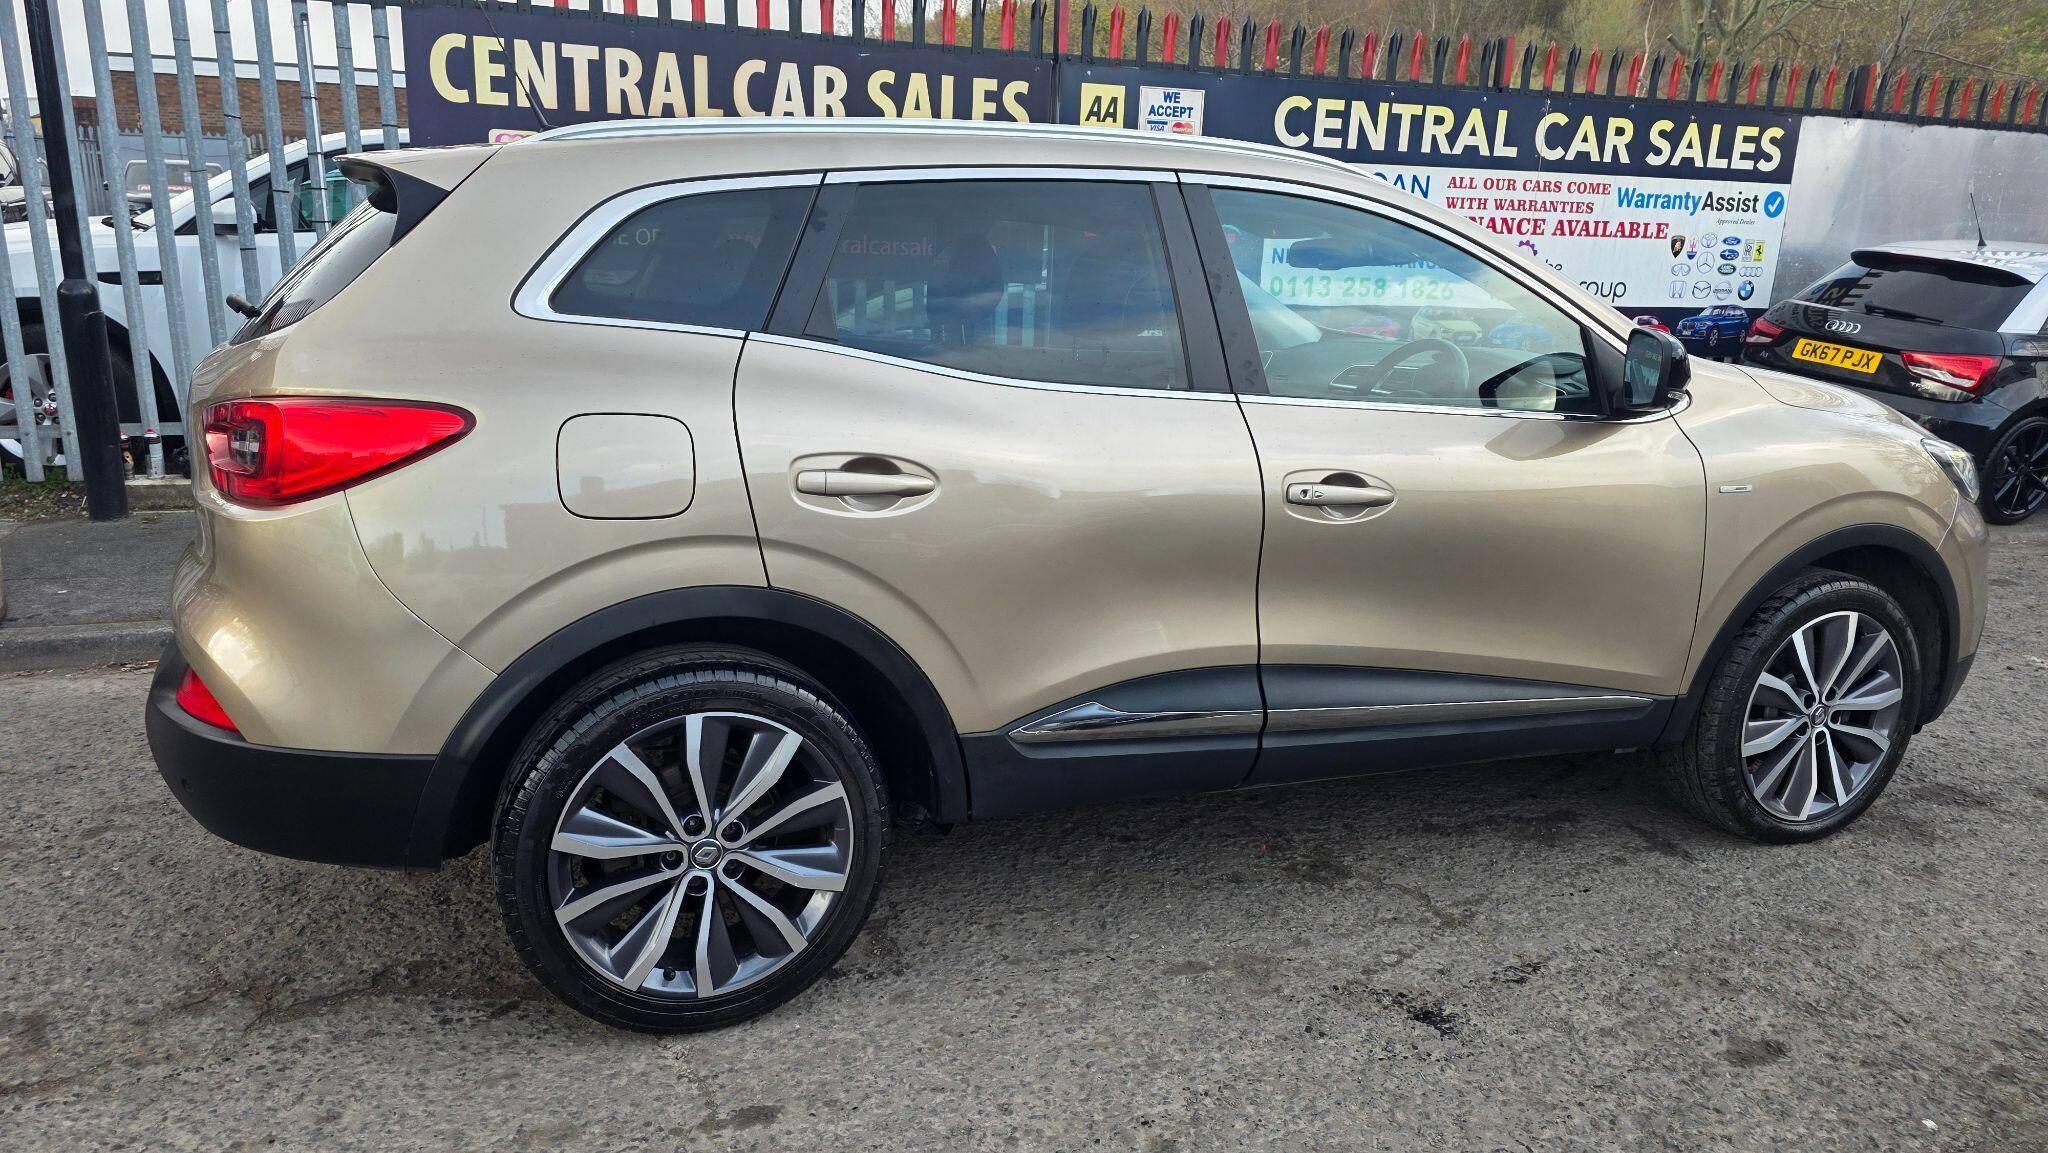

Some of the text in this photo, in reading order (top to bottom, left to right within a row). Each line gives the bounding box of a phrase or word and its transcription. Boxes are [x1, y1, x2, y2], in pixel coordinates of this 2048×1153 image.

[429, 33, 1030, 123] CENTRAL CAR SALES
[1163, 91, 1181, 103] WE
[1085, 95, 1119, 123] AA
[1148, 105, 1194, 118] ACCEPT
[1274, 95, 1785, 172] CENTRAL CAR SALES
[1373, 172, 1431, 199] AN
[1447, 176, 1612, 196] ALL OUR CARS COME
[1445, 196, 1595, 214] WITH WARRANTIES
[1464, 216, 1670, 240] ANCE AVAILABLE
[1269, 275, 1333, 297] 0113
[1342, 276, 1388, 298] 258
[1579, 281, 1627, 303] oup
[1800, 342, 1876, 370] GK67 PJX
